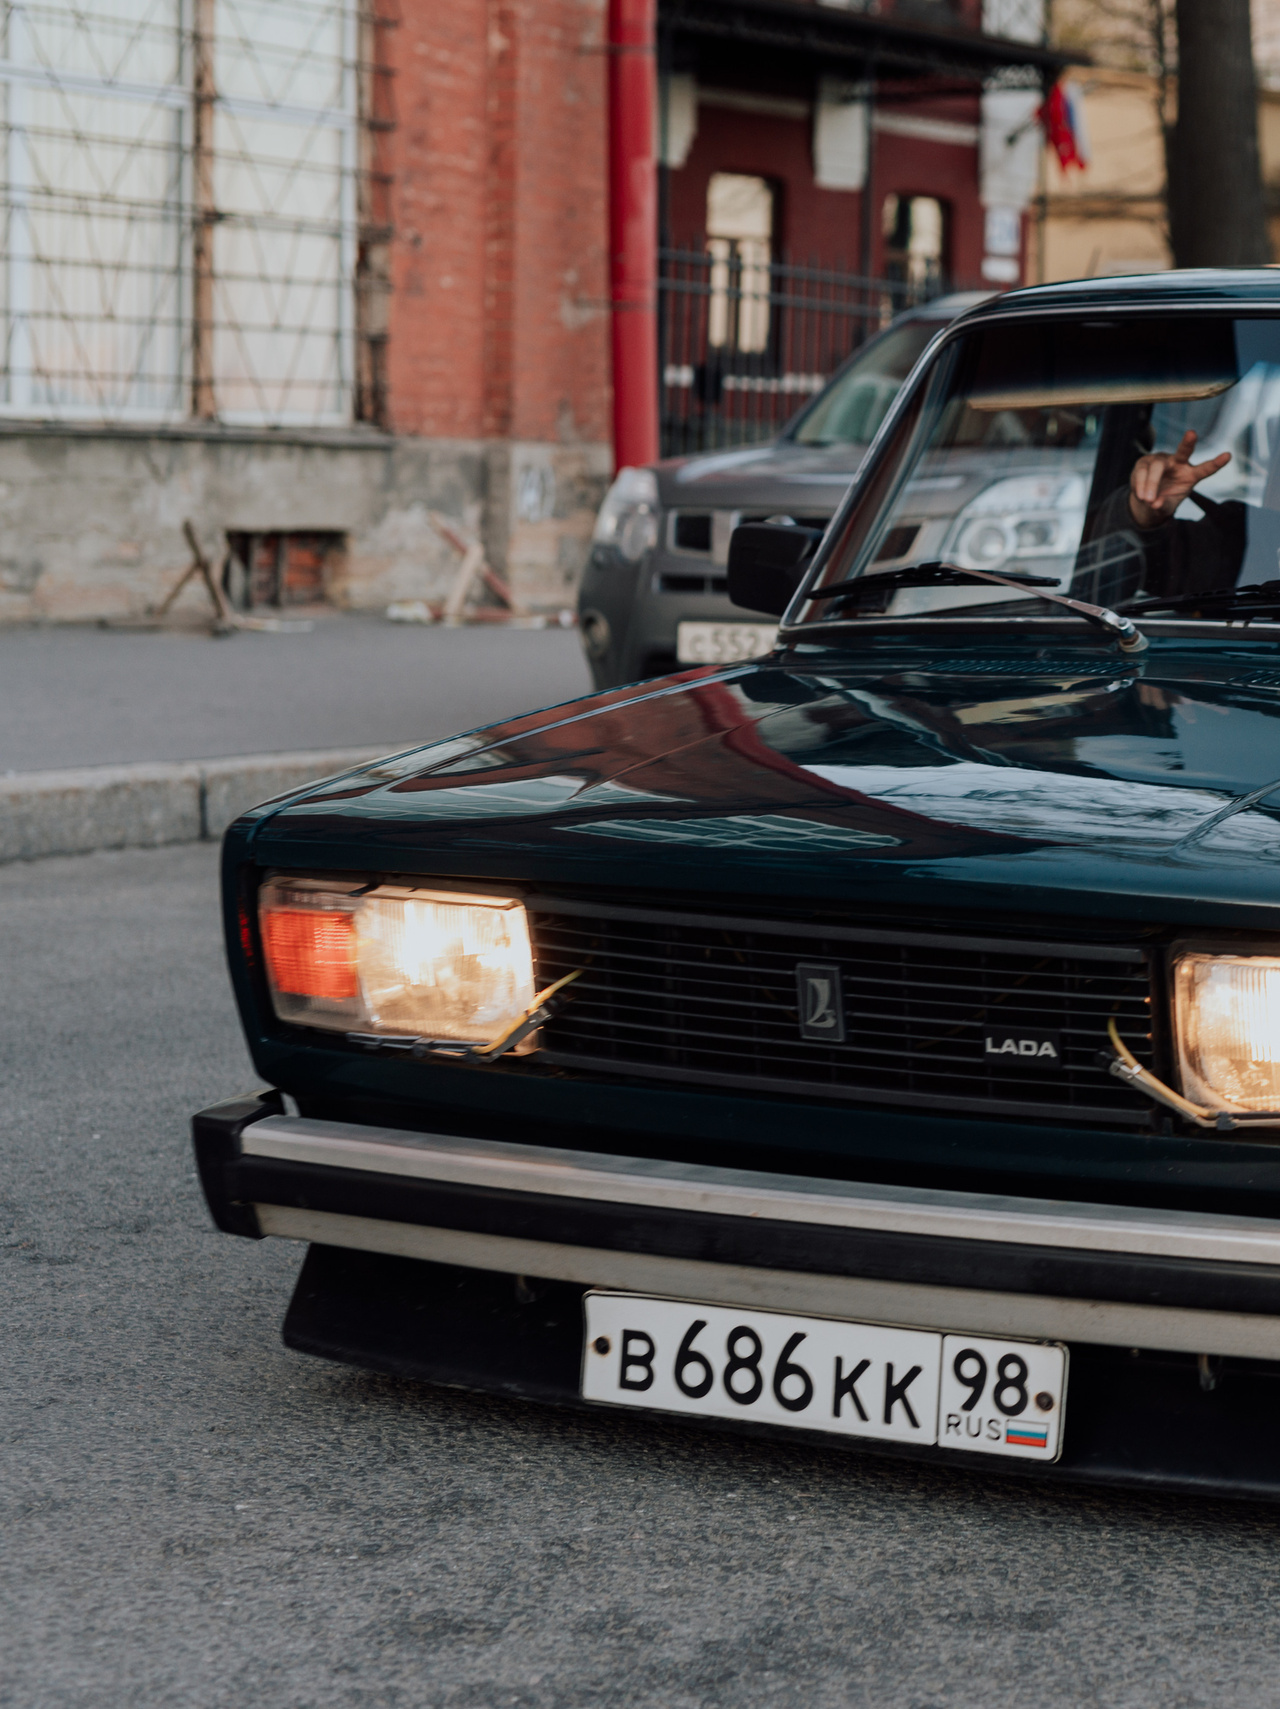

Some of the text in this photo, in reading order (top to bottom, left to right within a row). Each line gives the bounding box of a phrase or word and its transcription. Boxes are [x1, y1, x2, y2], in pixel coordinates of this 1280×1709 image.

[985, 1037, 1058, 1058] LADA
[953, 1348, 1028, 1417] 98
[945, 1413, 1001, 1441] RUS
